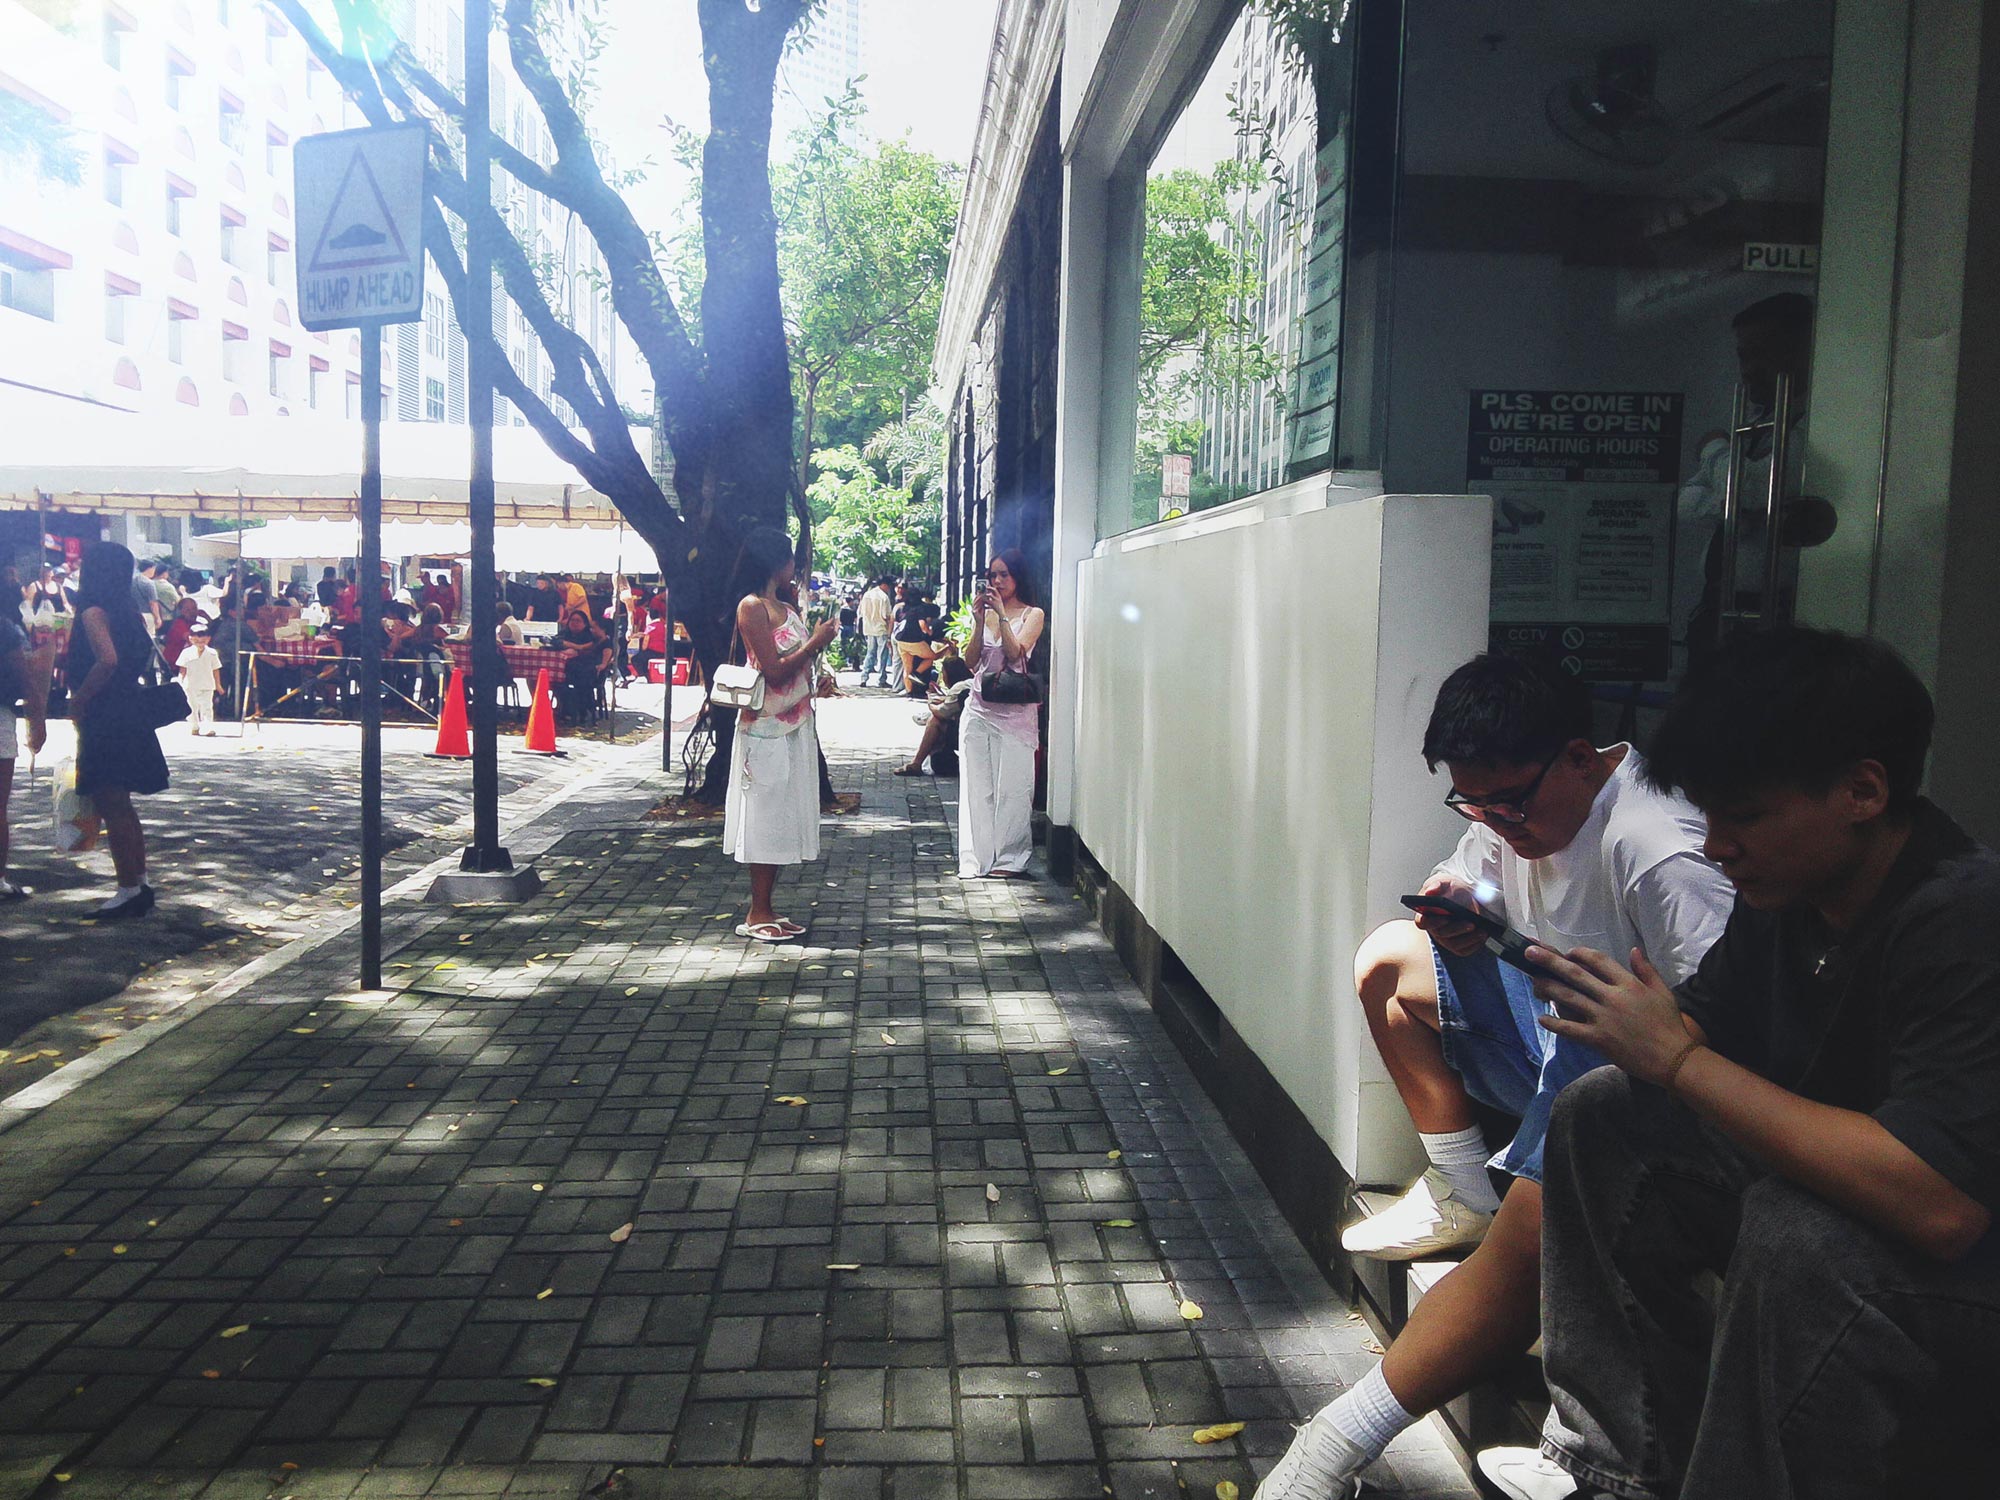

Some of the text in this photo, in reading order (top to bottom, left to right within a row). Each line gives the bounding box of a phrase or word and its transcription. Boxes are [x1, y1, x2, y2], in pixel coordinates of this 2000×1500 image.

[1748, 247, 1813, 268] PULL
[306, 270, 415, 312] HUMP AHEAD
[1481, 393, 1671, 413] PLS. COME IN
[1489, 412, 1661, 432] WE'RE OPEN
[1489, 436, 1659, 455] OPERATING HOURS
[1480, 456, 1579, 468] Monday Saturday
[1508, 629, 1550, 641] CCTV
